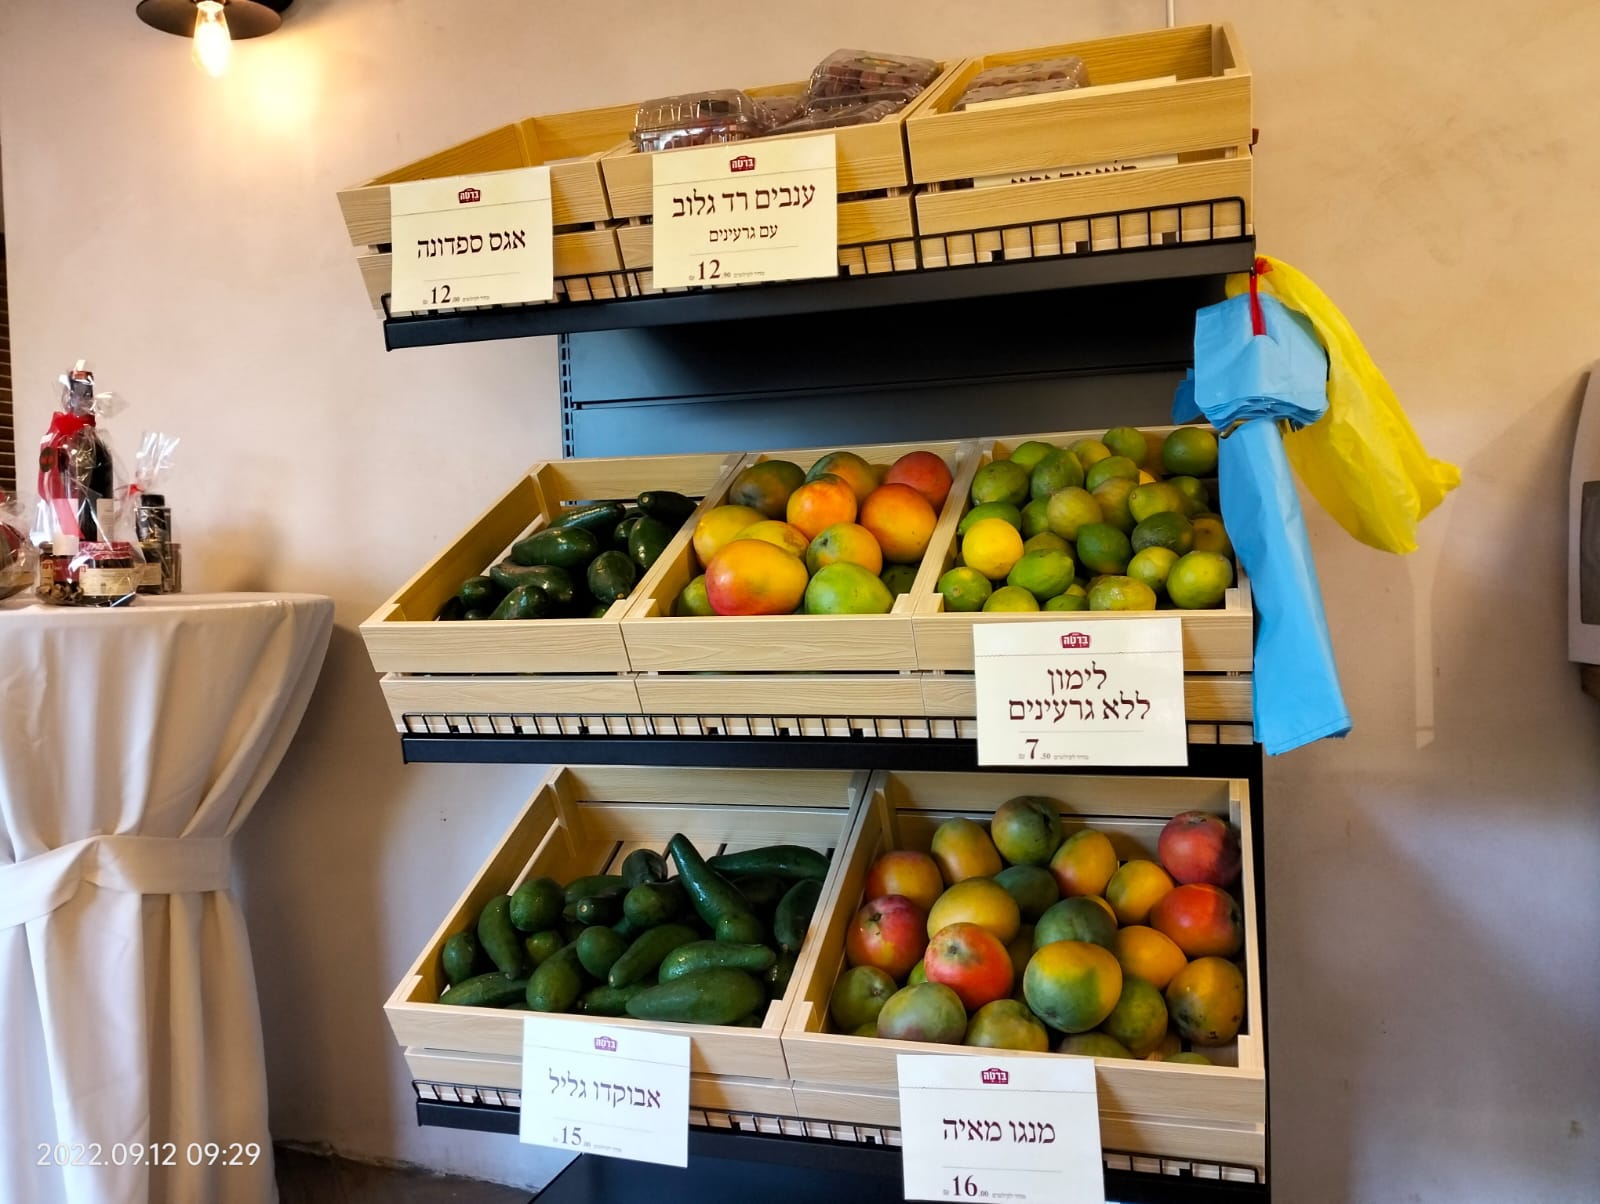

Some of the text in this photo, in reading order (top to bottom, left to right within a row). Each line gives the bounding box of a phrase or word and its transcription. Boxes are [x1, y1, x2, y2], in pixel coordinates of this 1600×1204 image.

[672, 184, 816, 218] ענבים רד גלוב
[417, 229, 526, 259] אגס ספדונה
[709, 225, 778, 242] עם גרעינים
[1047, 660, 1108, 696] לימון
[1008, 690, 1151, 724] ללא גרעינים
[548, 1067, 661, 1109] אבוקדו גליל
[942, 1117, 1056, 1144] מנגו מאיה
